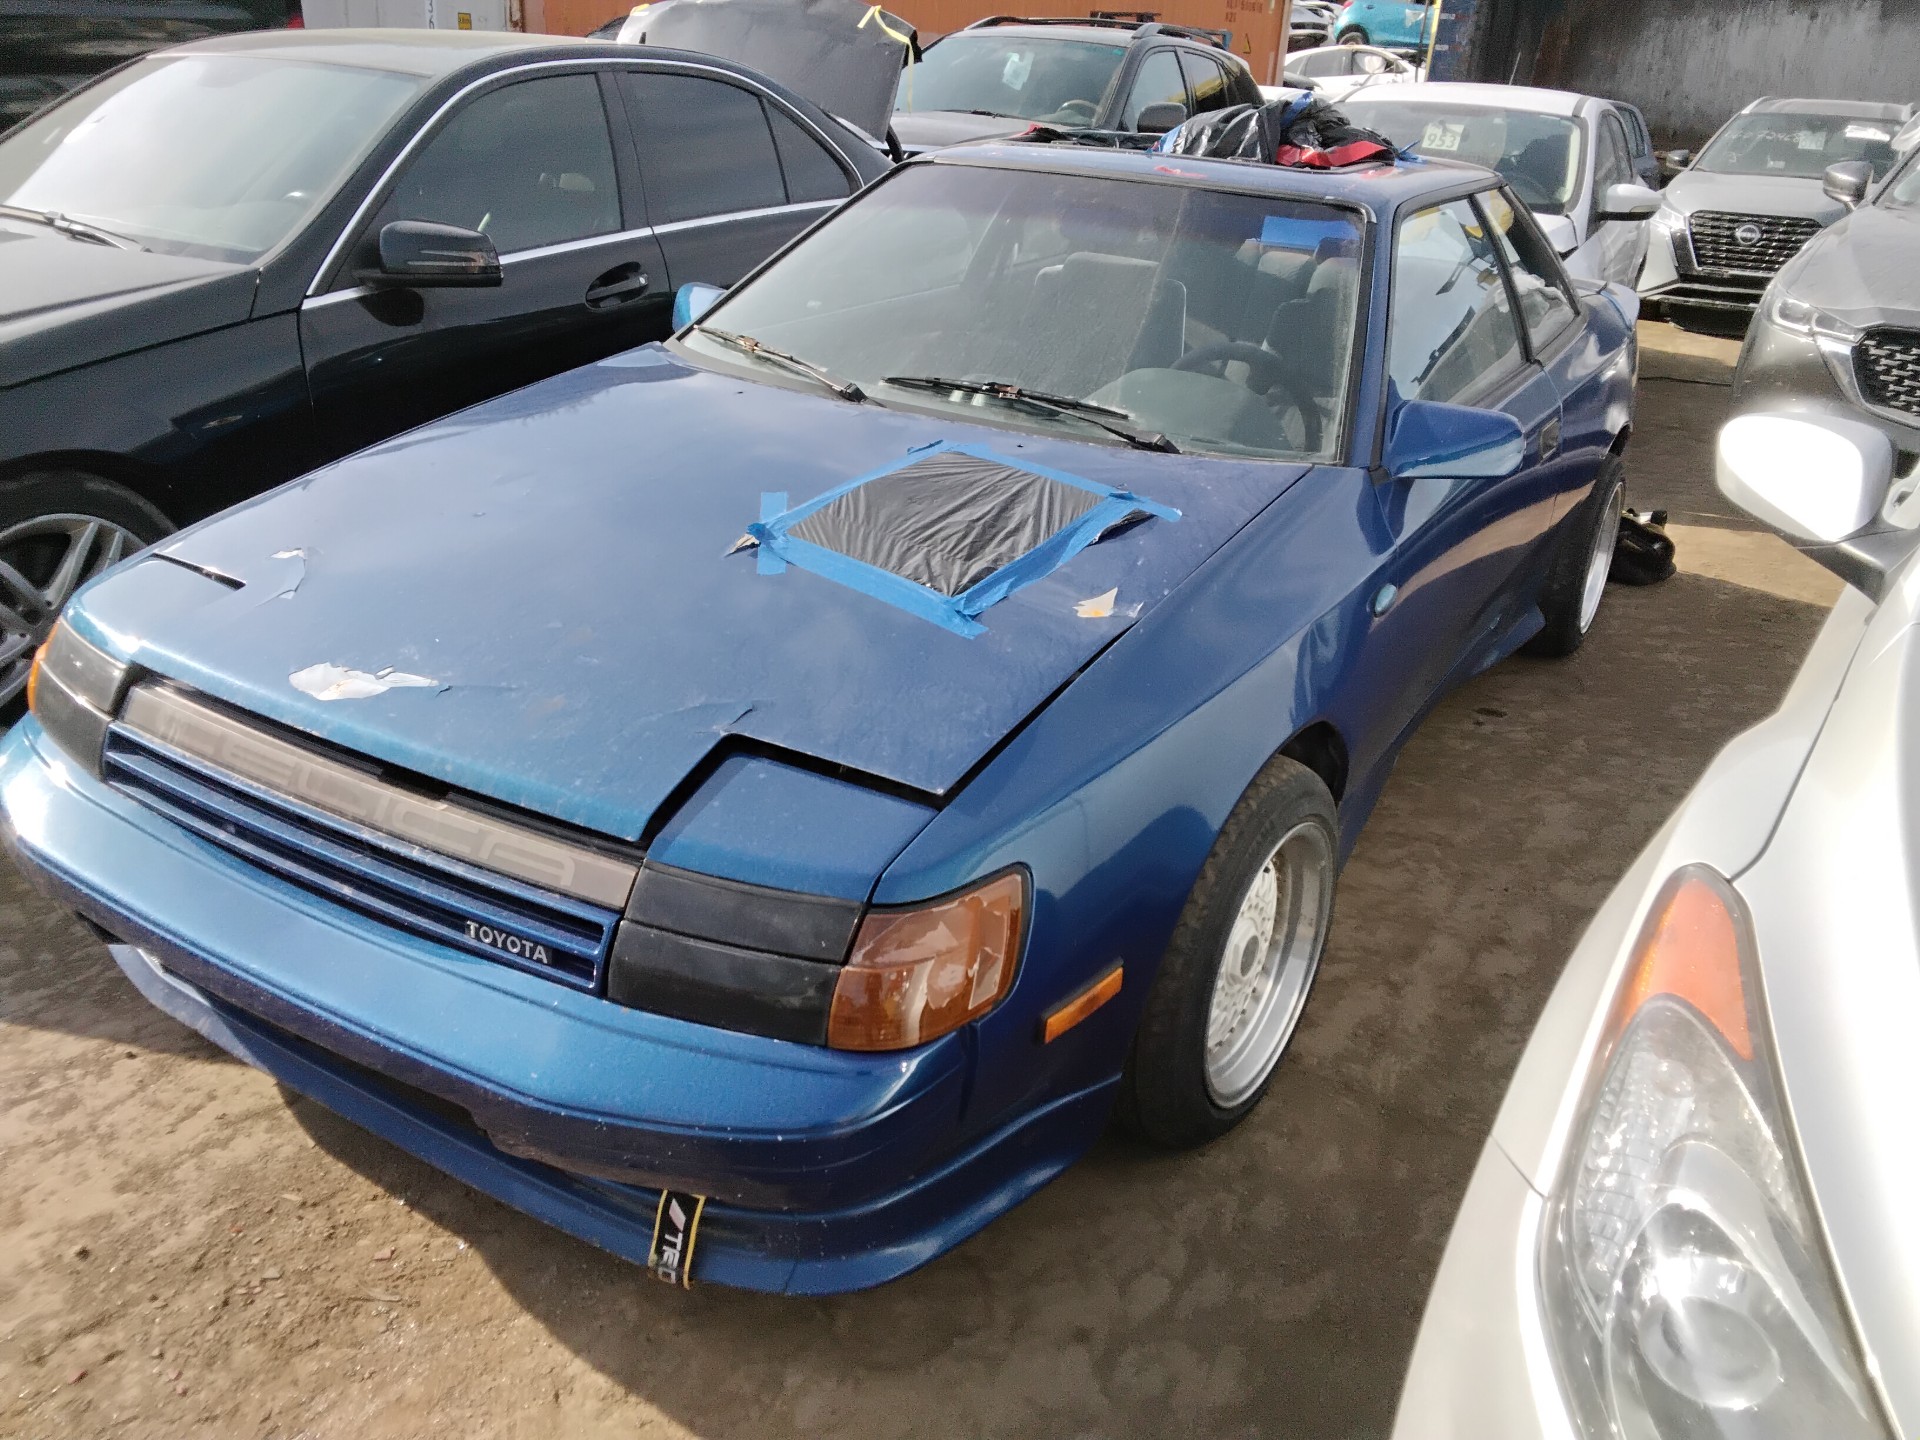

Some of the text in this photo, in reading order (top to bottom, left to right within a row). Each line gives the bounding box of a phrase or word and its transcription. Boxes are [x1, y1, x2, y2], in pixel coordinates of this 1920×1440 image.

[1427, 132, 1457, 149] 953
[160, 708, 575, 887] CELICA
[466, 920, 548, 964] TOYOTA
